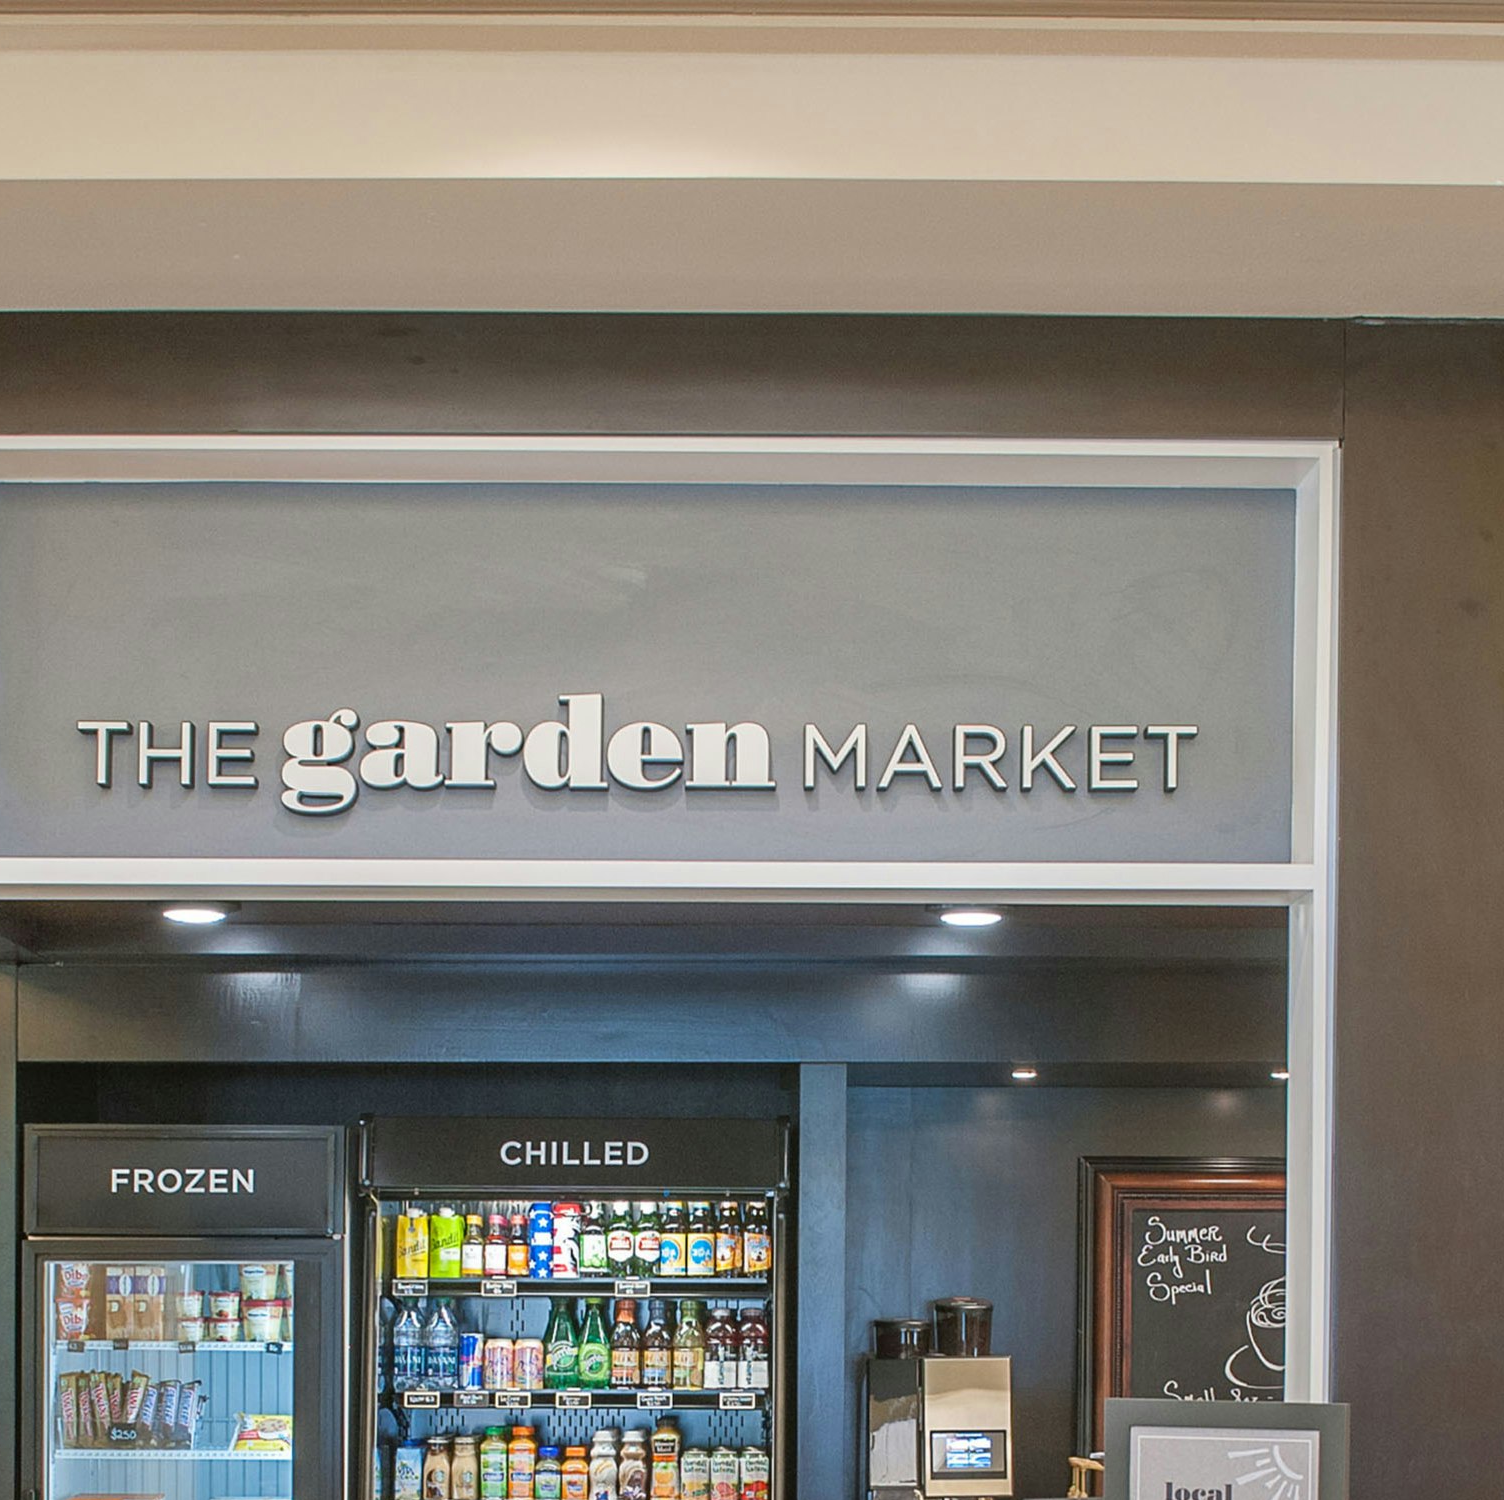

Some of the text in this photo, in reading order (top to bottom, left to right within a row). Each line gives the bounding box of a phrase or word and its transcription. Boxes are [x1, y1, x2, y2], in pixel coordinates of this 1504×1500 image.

[77, 693, 1201, 816] THE garden MARKET
[500, 1140, 650, 1167] CHILLED
[110, 1168, 255, 1194] FROZEN
[1138, 1245, 1183, 1278] Early
[1147, 1270, 1212, 1305] Special
